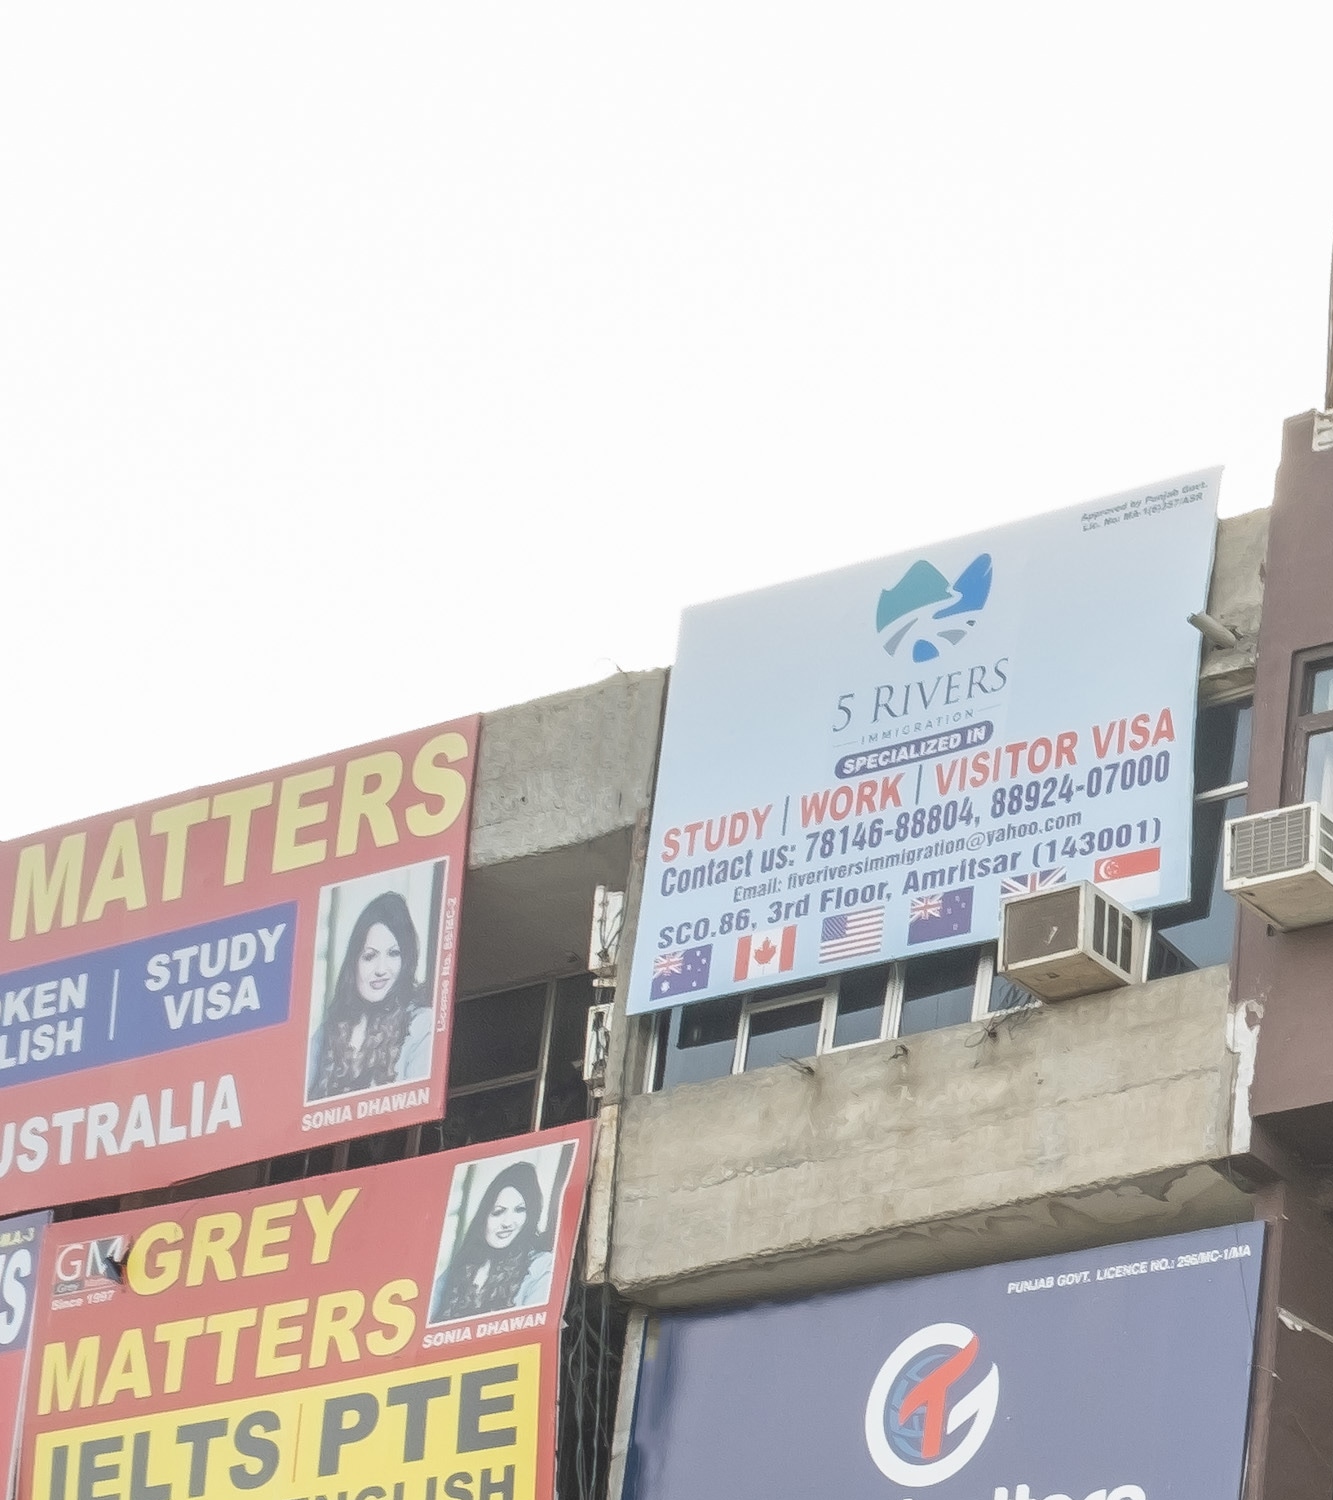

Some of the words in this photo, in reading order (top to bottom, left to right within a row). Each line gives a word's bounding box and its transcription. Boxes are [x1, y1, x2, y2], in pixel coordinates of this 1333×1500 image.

[832, 693, 855, 733] 5
[873, 657, 1009, 725] RIVERS
[861, 708, 974, 745] IMMIGRATION
[661, 804, 772, 863] STUDY
[801, 772, 903, 828] WORK
[936, 731, 1078, 797] VISITOR
[1092, 707, 1175, 759] VISA
[844, 733, 961, 773] SPECIALIZED
[967, 727, 986, 746] IN
[9, 732, 469, 942] MATTERS
[661, 850, 753, 897] Contact
[761, 844, 796, 873] us:
[991, 750, 1170, 819] 88924-07000
[734, 879, 782, 903] Email:
[767, 894, 810, 924] 3rd
[819, 880, 892, 913] Floor,
[902, 851, 1021, 896] Amritsar
[1032, 817, 1161, 868] (143001)
[2, 973, 88, 1027] KEN
[145, 924, 287, 991] STUDY
[163, 976, 260, 1030] VISA
[301, 1105, 352, 1131] SONIA
[357, 1088, 430, 1121] DHAWAN
[126, 1188, 360, 1296] GREY
[1008, 1276, 1053, 1294] PUNJAB
[1057, 1271, 1090, 1287] GOVT.
[36, 1279, 419, 1416] MATTERS
[422, 1326, 471, 1350] SONIA
[476, 1312, 546, 1344] DHAWAN
[318, 1364, 518, 1477] PTE
